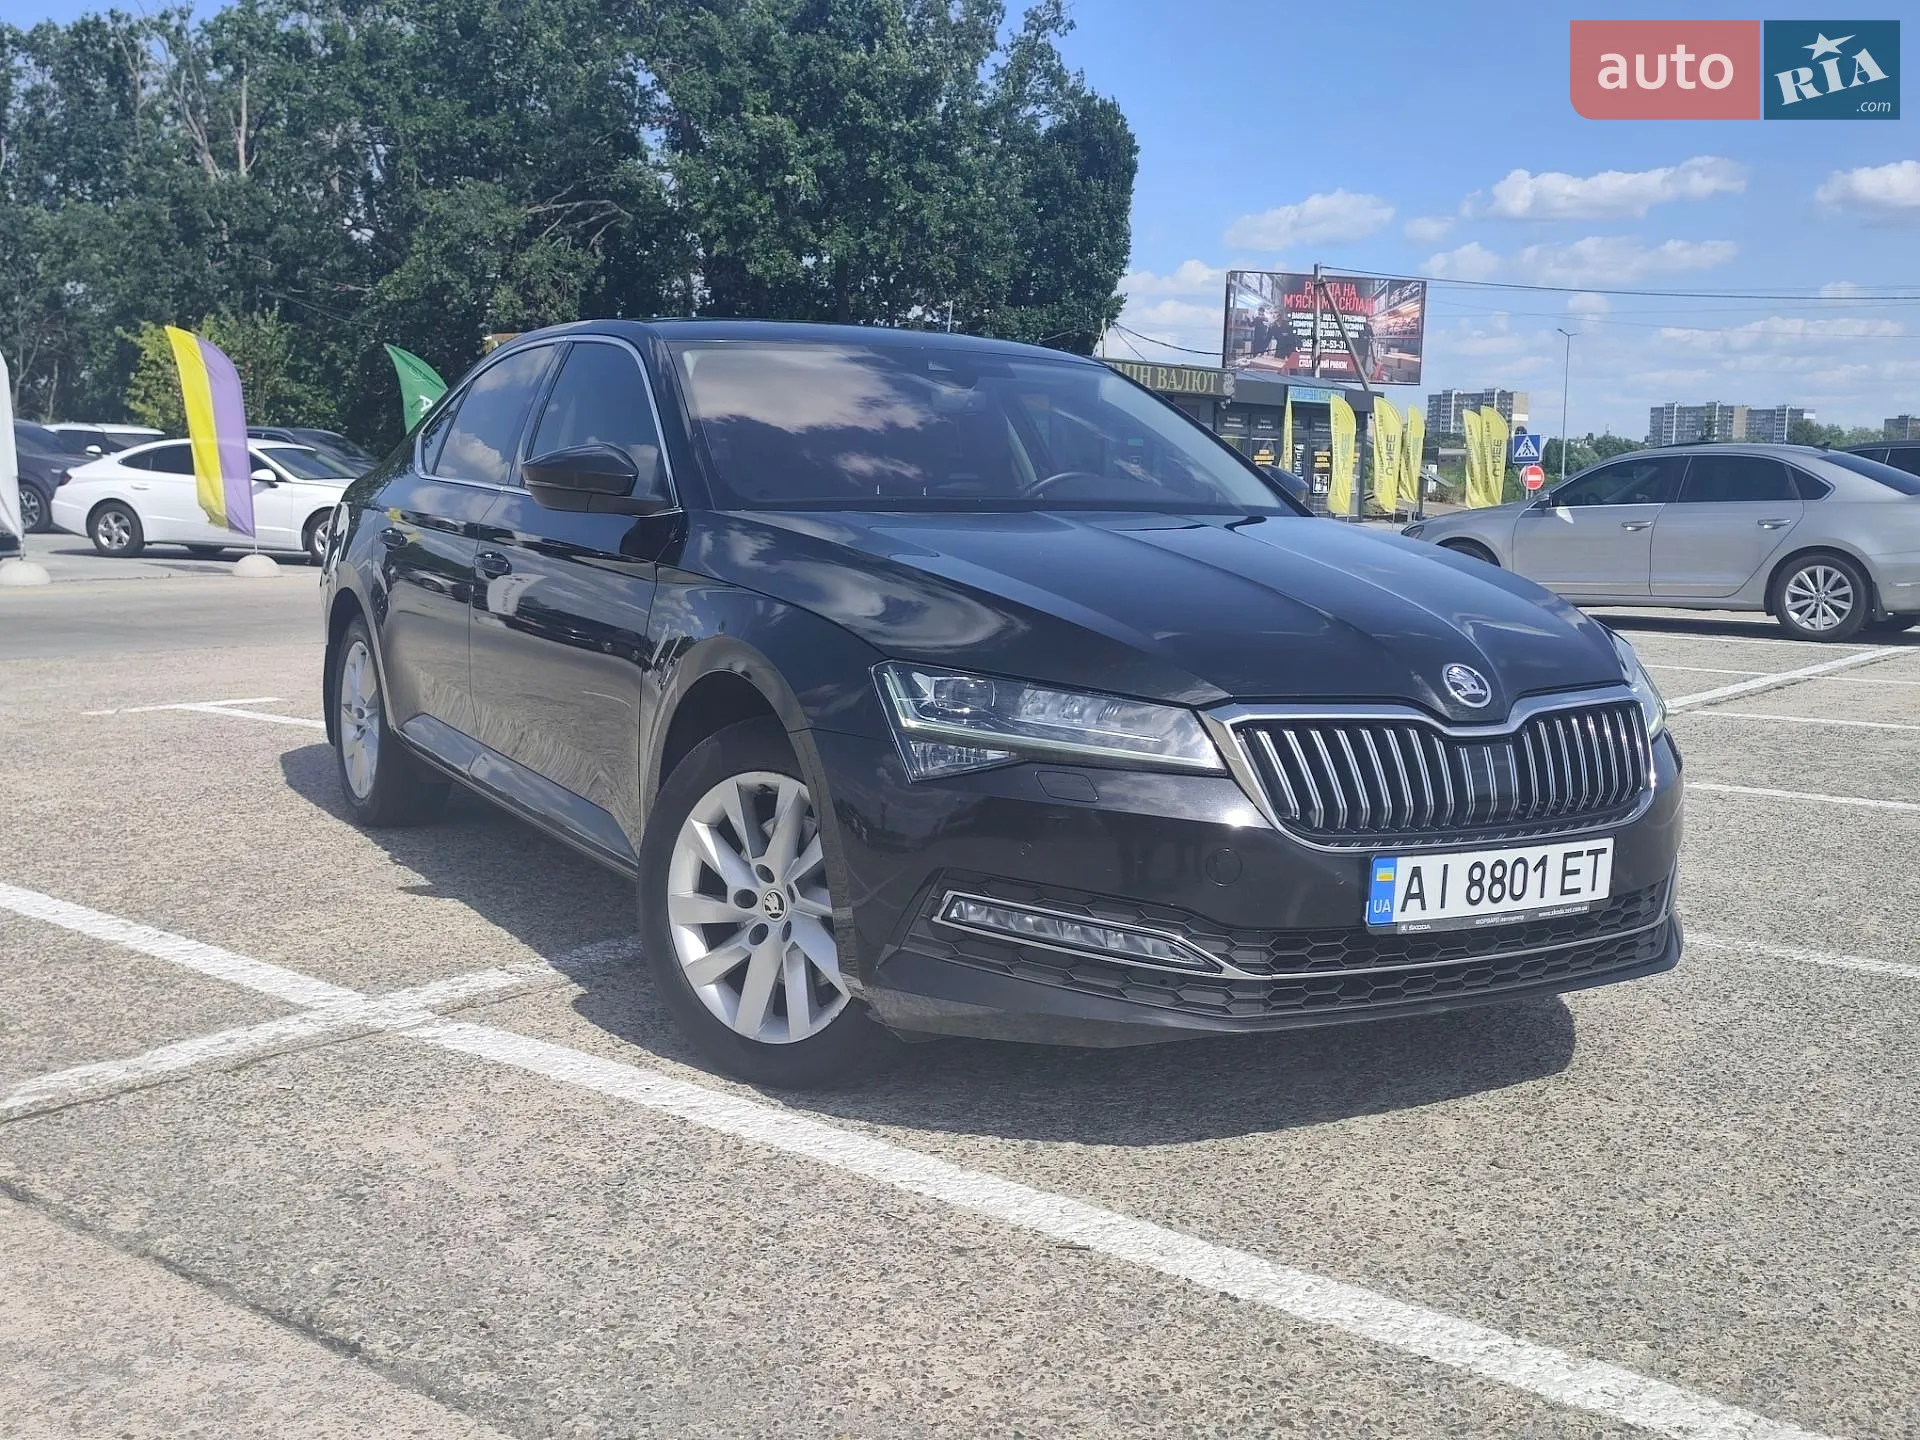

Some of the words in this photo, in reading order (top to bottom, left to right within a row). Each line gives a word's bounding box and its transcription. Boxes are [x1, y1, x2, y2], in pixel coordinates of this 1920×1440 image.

[1343, 283, 1357, 297] НА
[1157, 367, 1217, 393] ВАЛЮТ
[1400, 864, 1449, 912] AI
[1466, 854, 1548, 906] 8801
[1560, 848, 1607, 896] ET
[1374, 899, 1391, 914] UA
